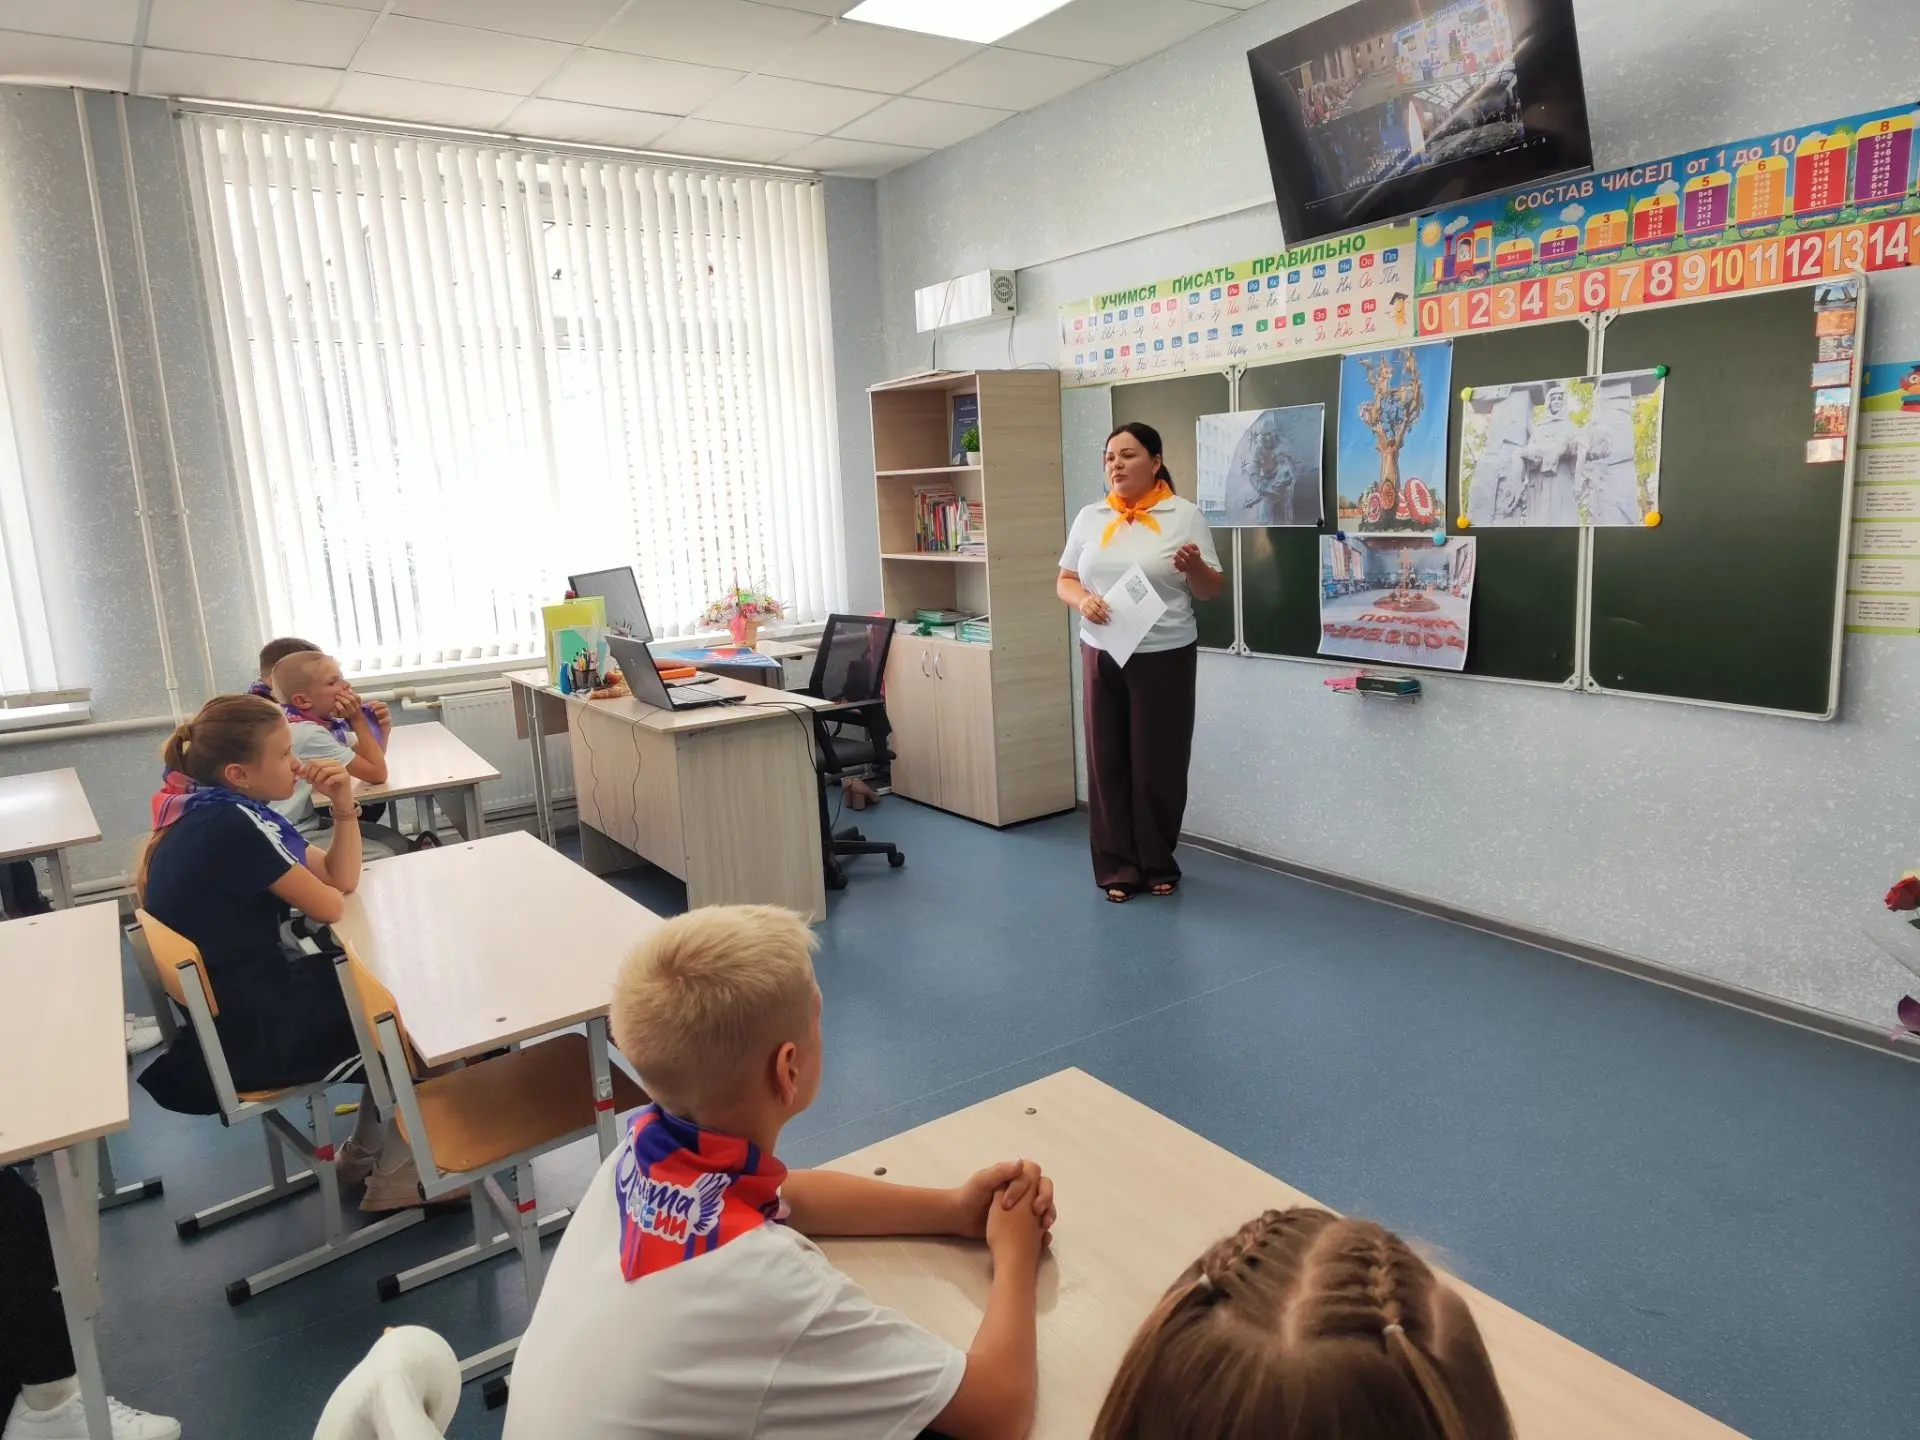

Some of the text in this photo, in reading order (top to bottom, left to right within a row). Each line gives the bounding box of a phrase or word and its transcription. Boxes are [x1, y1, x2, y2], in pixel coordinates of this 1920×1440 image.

[1880, 121, 1889, 132] 8
[1819, 140, 1827, 149] 7
[1758, 160, 1766, 170] 6
[1514, 180, 1593, 211] СОСТАВ
[1601, 161, 1672, 192] ЧИСЕЛ
[1716, 150, 1725, 167] 1
[1771, 135, 1796, 155] 10
[1702, 176, 1710, 186] 5
[1652, 197, 1660, 206] 4
[1603, 214, 1610, 223] 3
[1556, 228, 1563, 238] 2
[1101, 285, 1156, 310] УЧИМСЯ
[1172, 266, 1235, 294] ПИСАТЬ
[1252, 234, 1366, 276] ПРАВИЛЬНО
[1422, 300, 1439, 331] 0
[1448, 295, 1461, 327] 1
[1470, 292, 1490, 325] 2
[1497, 288, 1517, 320] 3
[1521, 282, 1543, 315] 4
[1553, 278, 1576, 311] 5
[1584, 271, 1606, 306] 6
[1617, 266, 1640, 302] 7
[1650, 260, 1673, 296] 8
[1682, 254, 1706, 292] 9
[1711, 248, 1744, 288] 10
[1750, 243, 1779, 282] 11
[1786, 236, 1823, 277] 12
[1828, 230, 1864, 272] 13
[1870, 222, 1908, 266] 14
